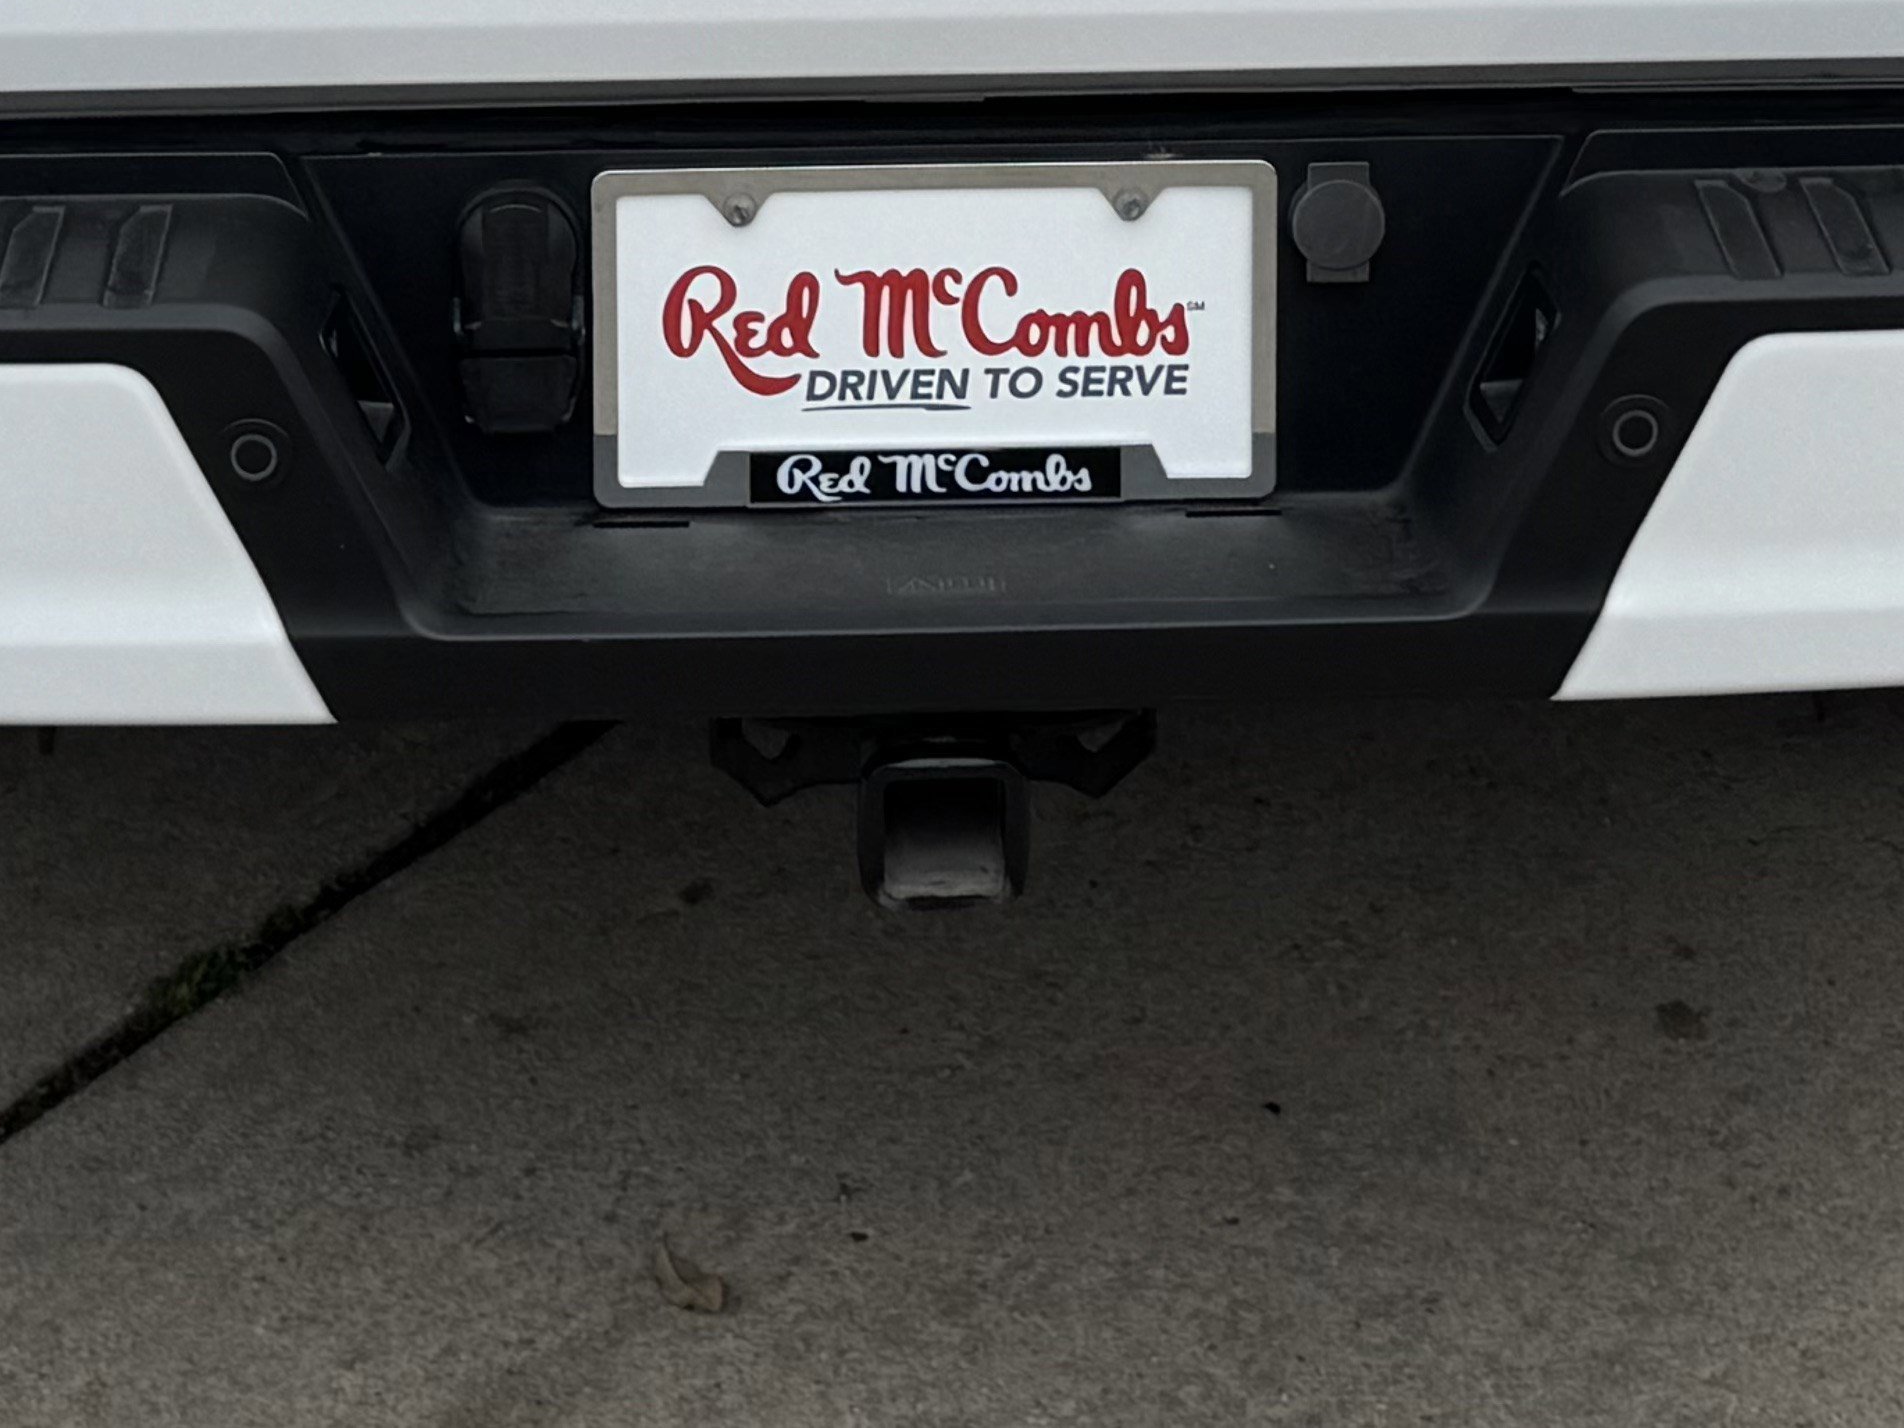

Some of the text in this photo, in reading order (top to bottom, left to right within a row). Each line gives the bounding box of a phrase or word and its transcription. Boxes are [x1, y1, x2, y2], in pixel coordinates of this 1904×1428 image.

[662, 265, 820, 396] Red
[834, 266, 1190, 358] McCombs
[805, 364, 1190, 403] DRIVEN TO SERVE
[776, 453, 1093, 503] Red McCombs
